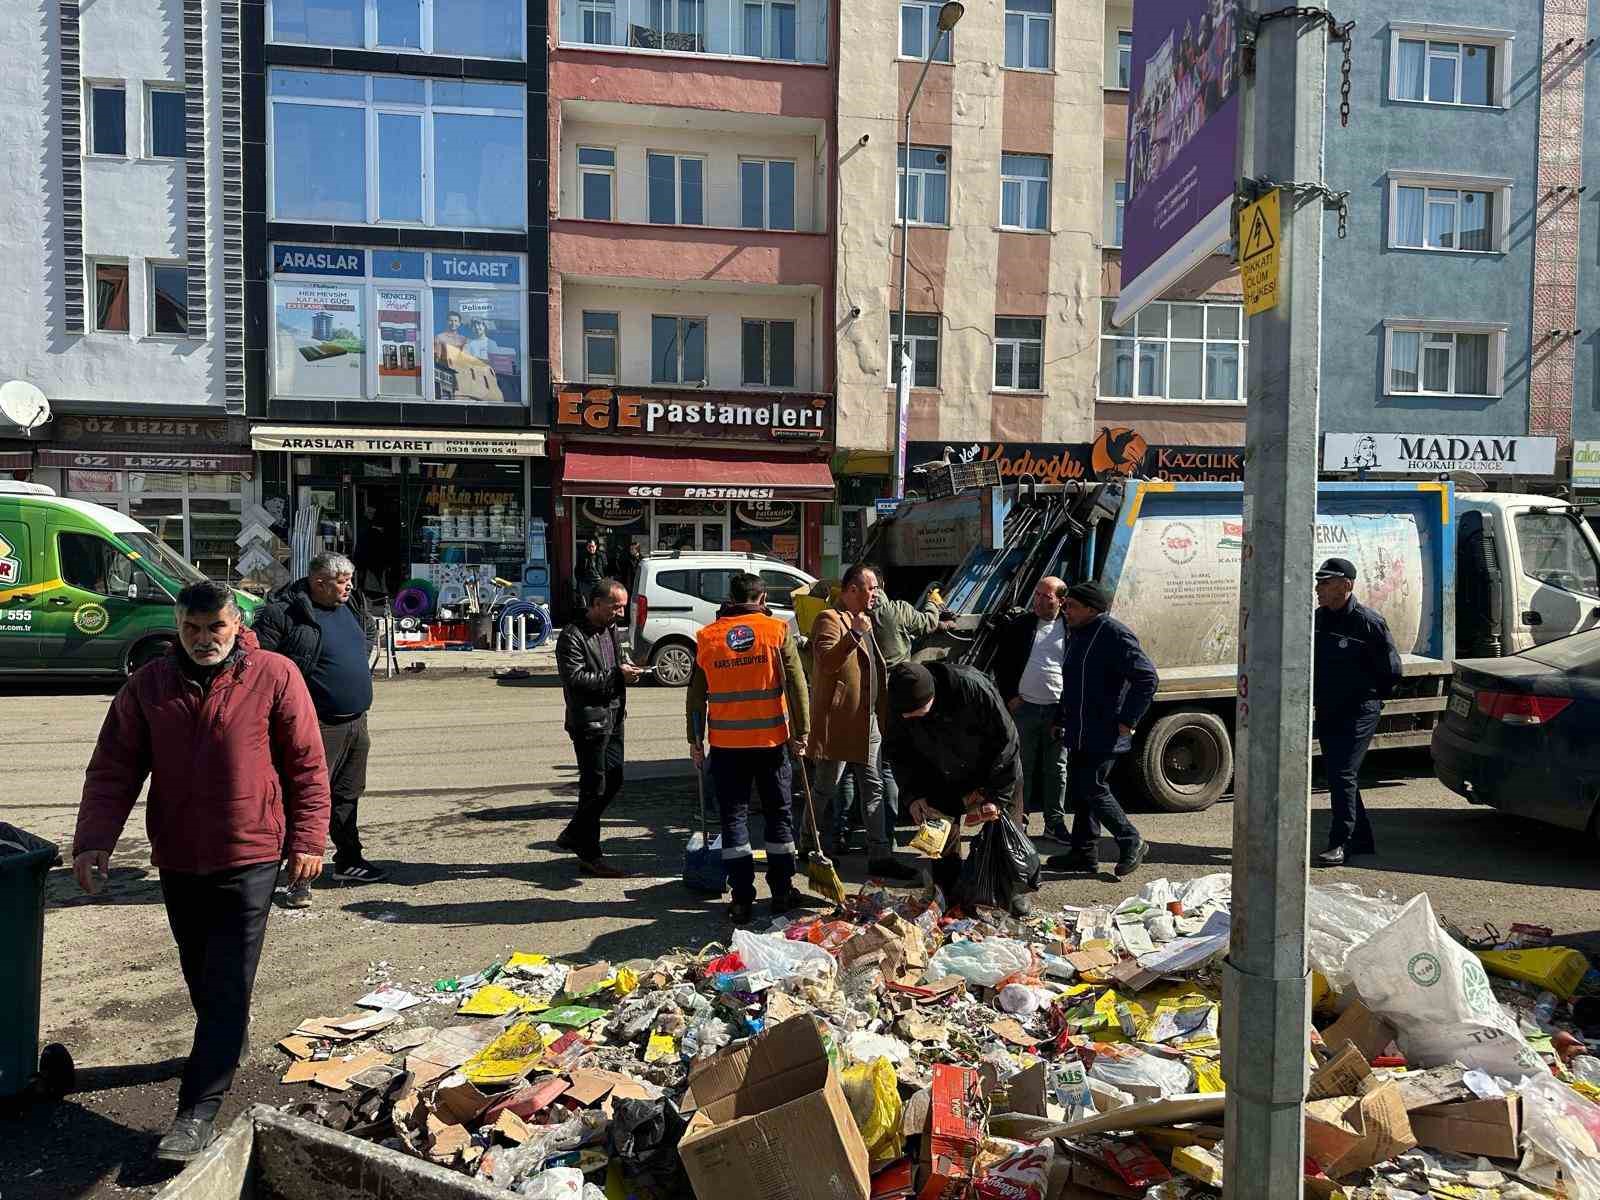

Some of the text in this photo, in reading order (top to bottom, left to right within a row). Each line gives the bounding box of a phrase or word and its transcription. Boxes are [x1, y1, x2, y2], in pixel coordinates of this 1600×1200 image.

[282, 253, 358, 270] ARASLAR
[443, 257, 511, 277] TİCARET
[557, 389, 825, 432] EGE pastaneleri
[85, 418, 199, 435] ÖZ LEZZET
[282, 439, 355, 449] ARASLAR
[1399, 437, 1517, 462] MADAM
[74, 453, 222, 469] ÖZ LEZZET
[1158, 448, 1240, 468] KAZCILIK
[1408, 460, 1504, 471] HOOKAH LOUNGE
[628, 485, 663, 497] EGE
[594, 498, 621, 508] EGE
[0, 562, 11, 576] R
[7, 609, 32, 621] 555
